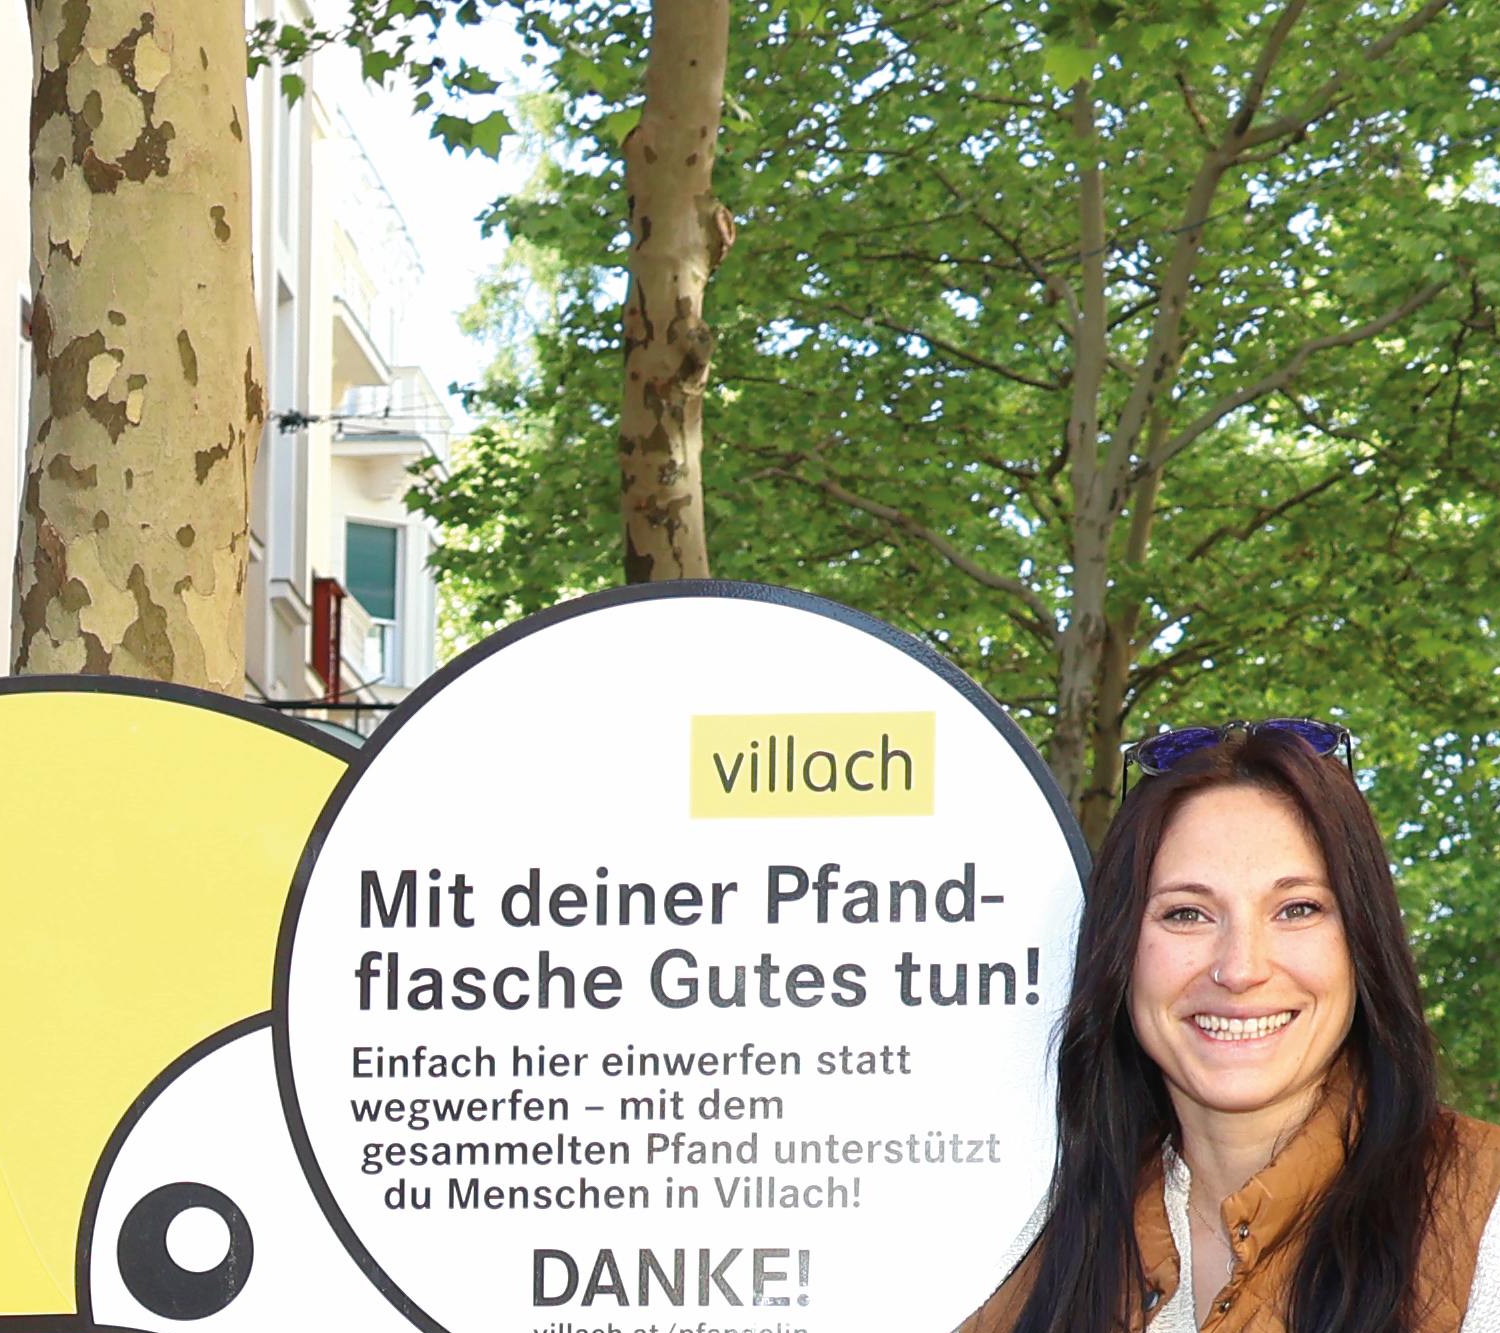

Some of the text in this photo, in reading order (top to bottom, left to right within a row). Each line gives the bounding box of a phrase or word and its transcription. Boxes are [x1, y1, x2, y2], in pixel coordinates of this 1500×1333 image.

[713, 734, 911, 793] villach
[361, 863, 1004, 928] Mit deiner Pfand-
[355, 947, 1039, 1010] flasche Gutes tun!
[353, 1043, 911, 1077] Einfach hier einwerfen statt
[351, 1089, 568, 1130] wegwerfen
[621, 1089, 684, 1120] mit
[699, 1088, 782, 1120] dem
[361, 1131, 1000, 1174] gesammelten Pfand unterstützt
[385, 1176, 859, 1209] du Menschen in Villach!
[533, 1249, 809, 1306] DANKE!
